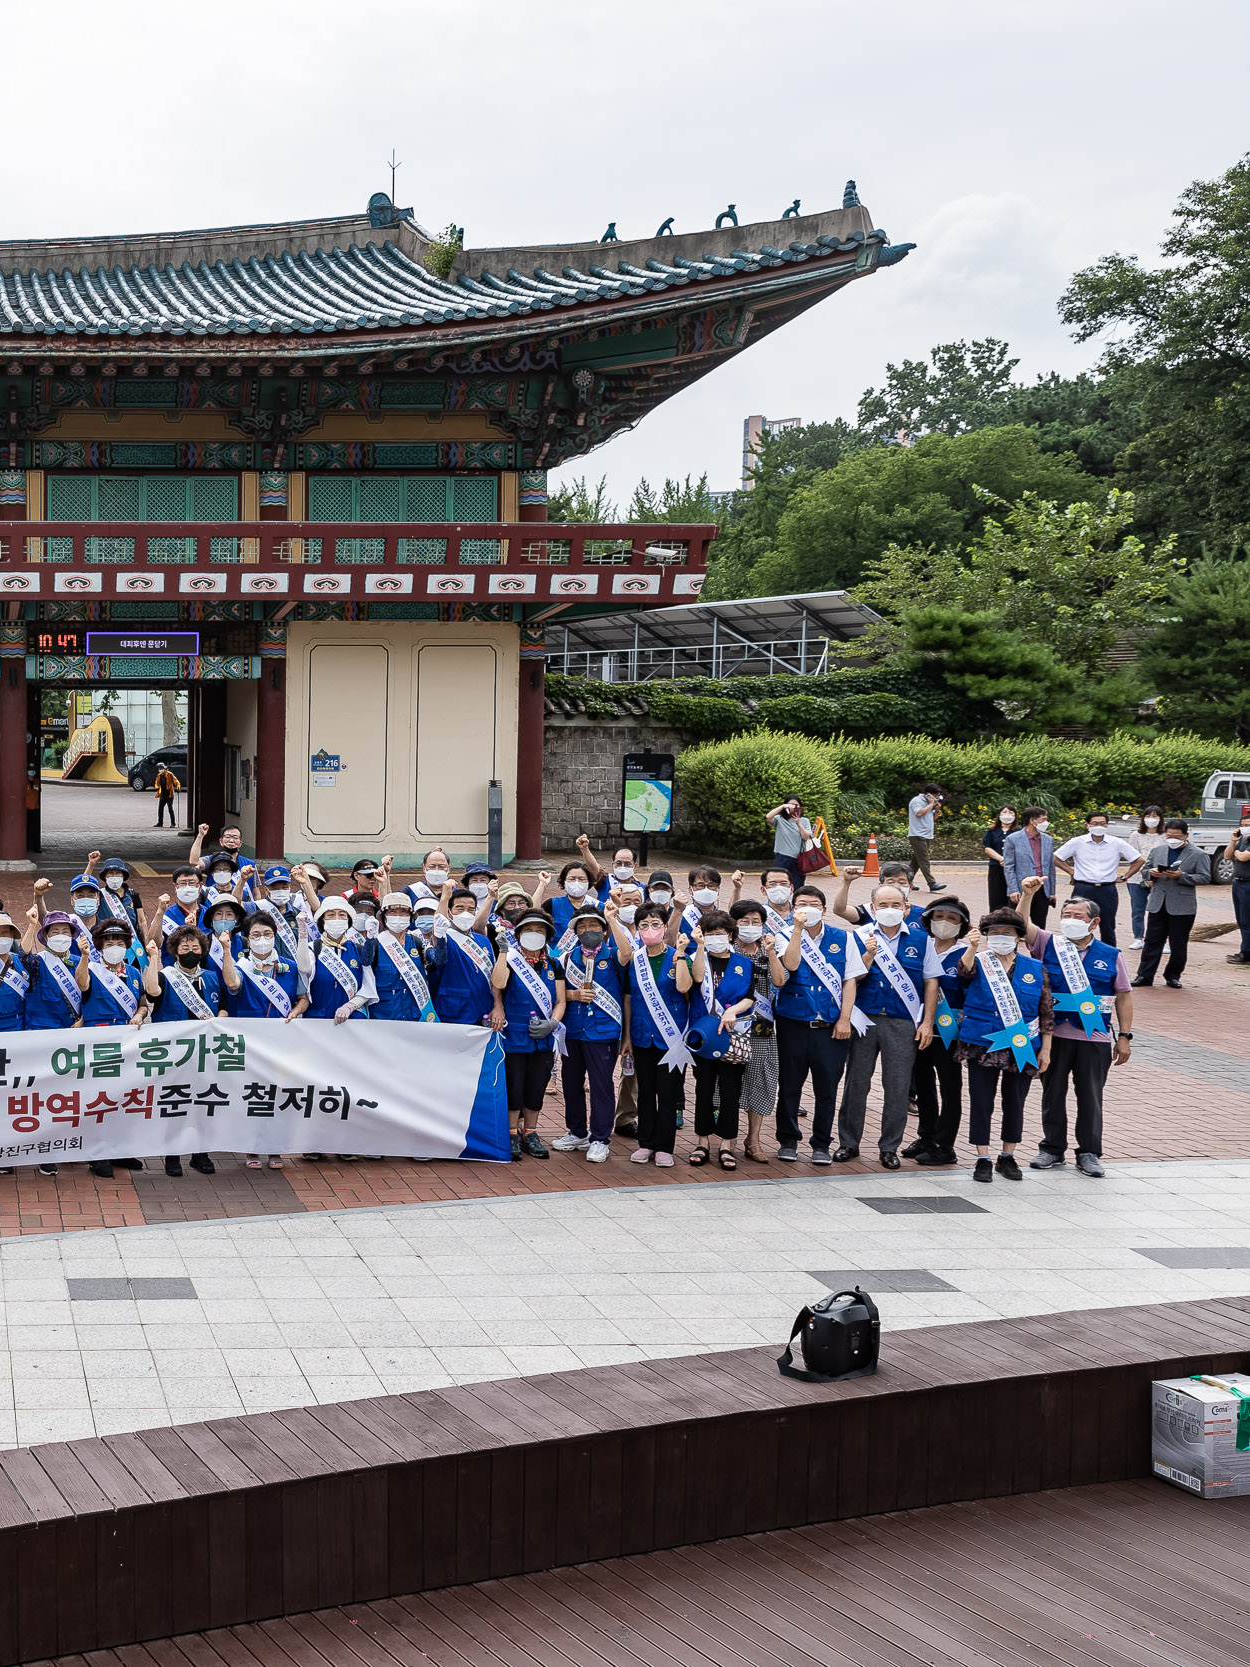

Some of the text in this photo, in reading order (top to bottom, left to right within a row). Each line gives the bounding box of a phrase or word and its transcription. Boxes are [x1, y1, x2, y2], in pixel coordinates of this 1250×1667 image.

[120, 640, 167, 649] 대피후엔 문닫기
[325, 759, 338, 767] 216
[51, 1042, 123, 1081] 여름
[136, 1033, 247, 1078] 휴가철
[243, 1082, 380, 1121] 철저히~
